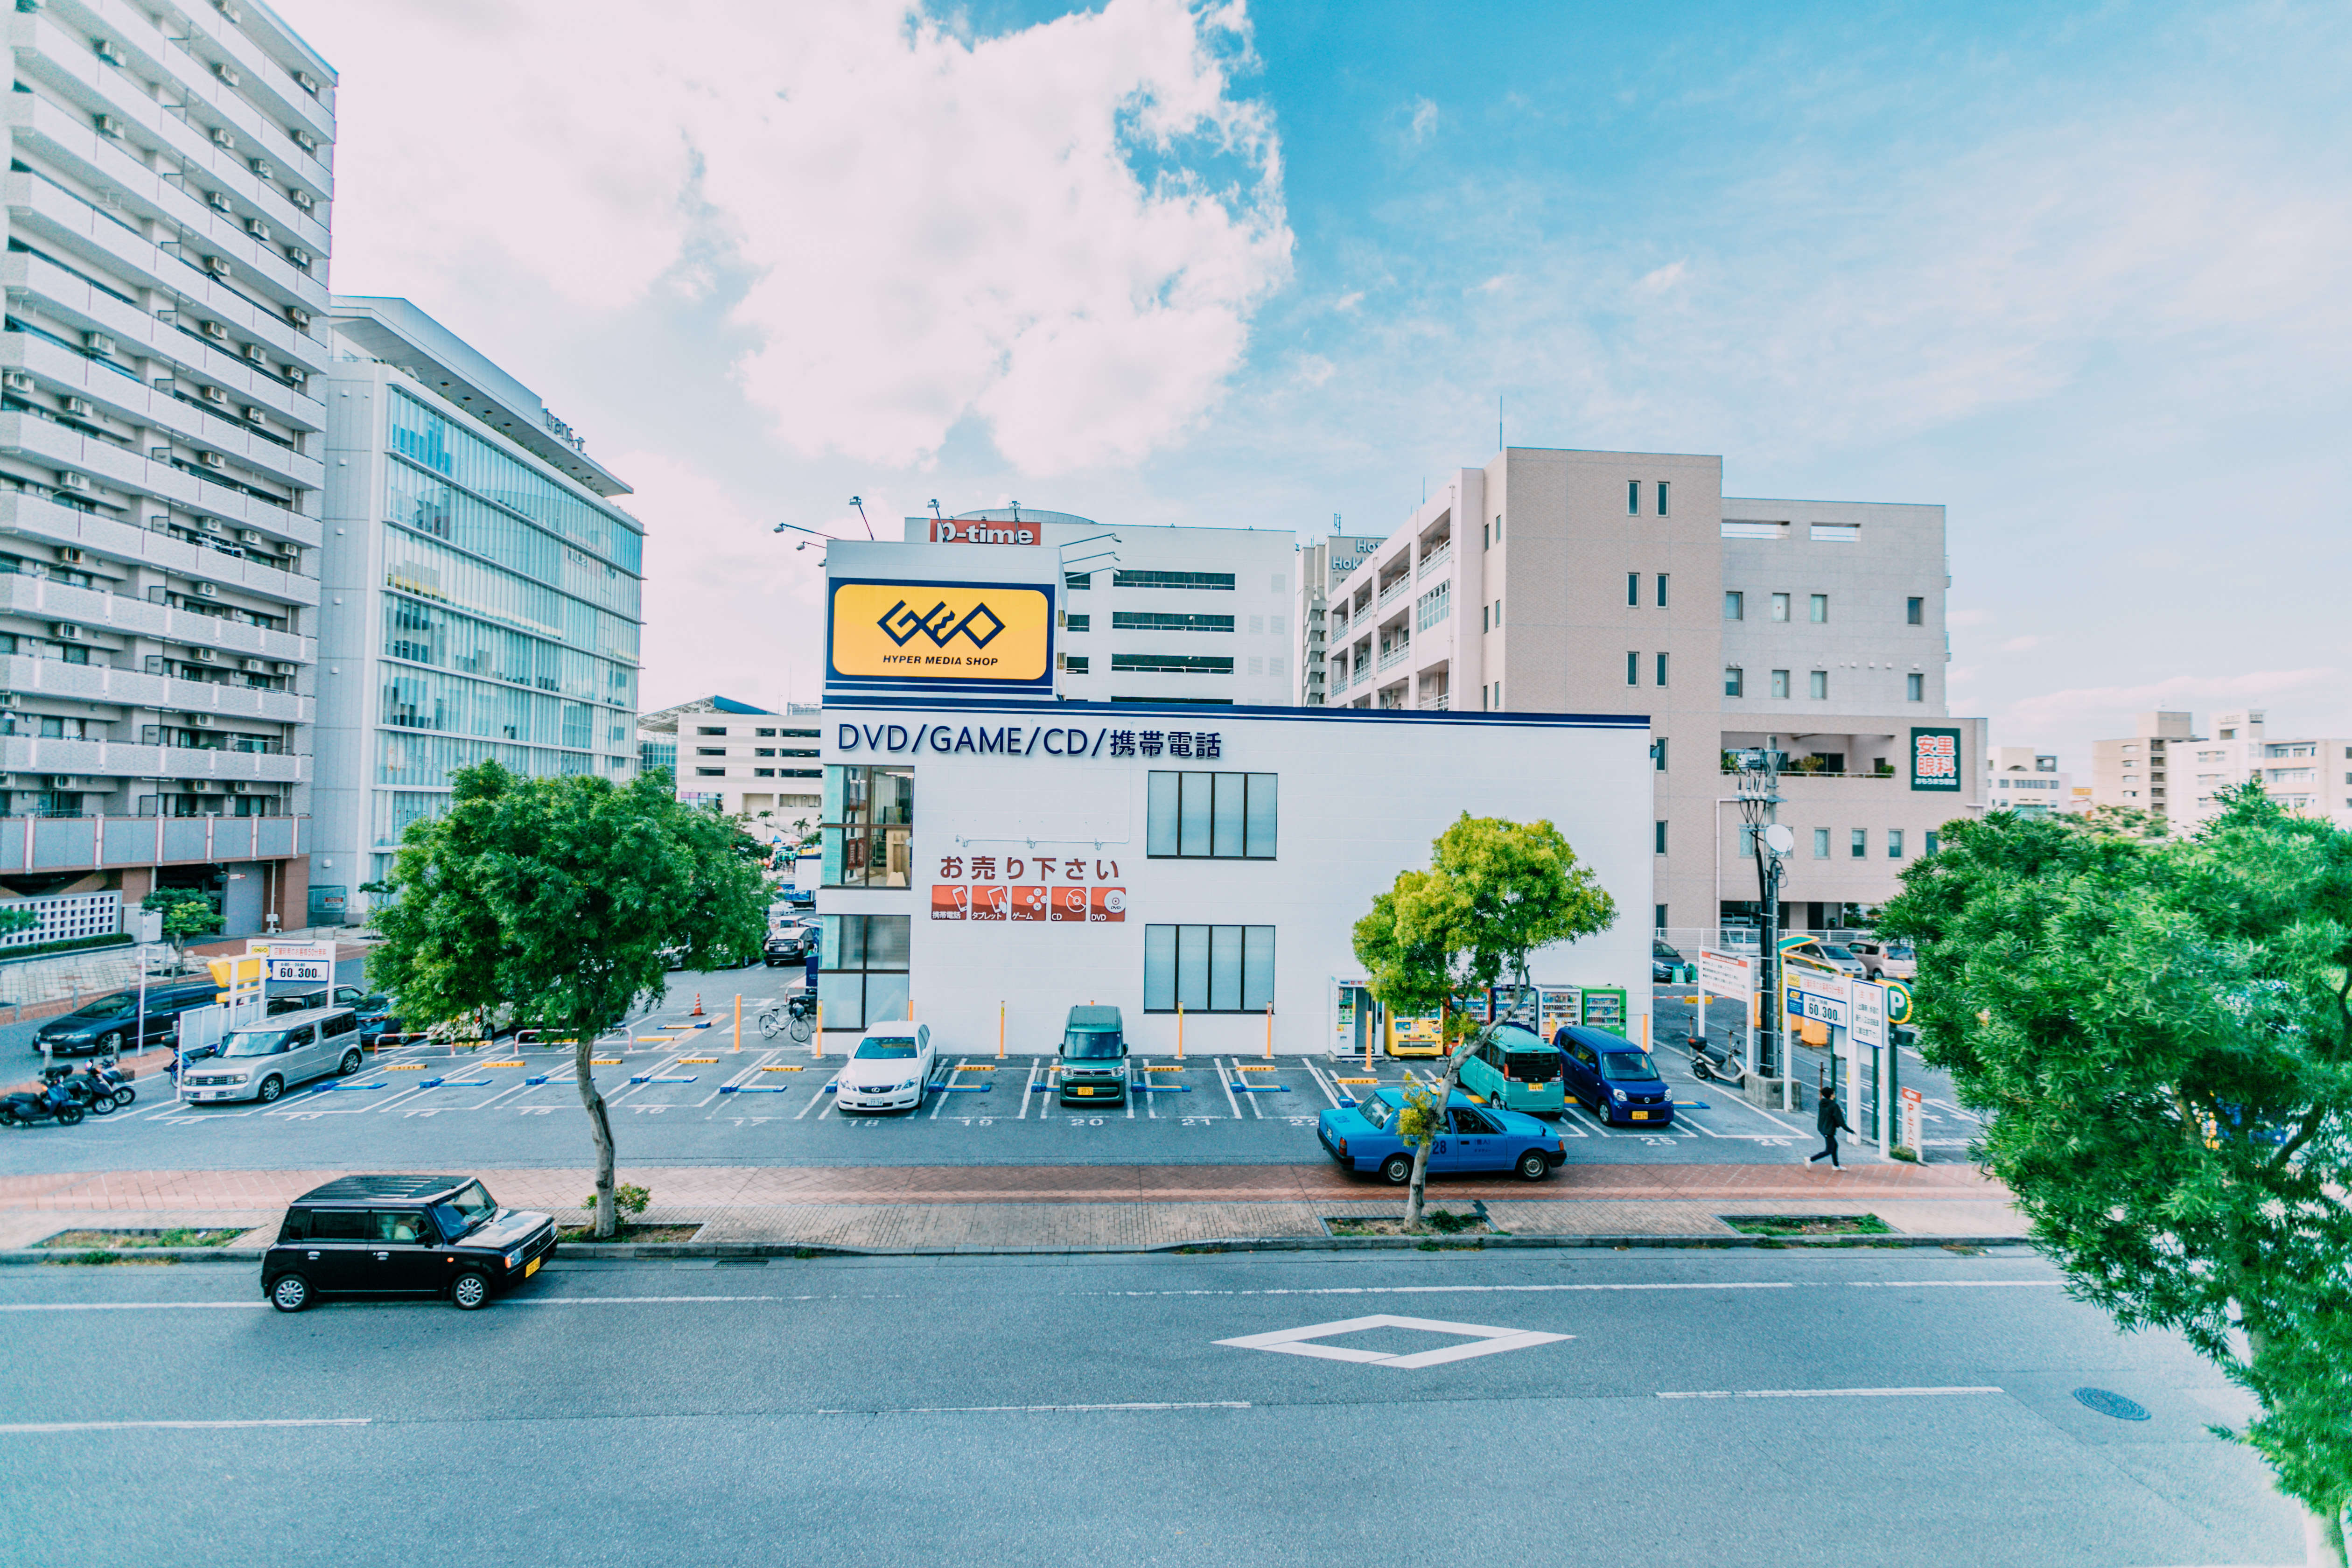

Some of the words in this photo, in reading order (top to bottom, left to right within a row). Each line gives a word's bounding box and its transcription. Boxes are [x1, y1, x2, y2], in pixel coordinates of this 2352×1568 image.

[877, 599, 1006, 649] GEO
[883, 655, 921, 664] HYPER
[925, 656, 961, 665] MEDIA
[966, 657, 998, 666] SHOP
[1916, 735, 1956, 756] 安里
[1916, 756, 1956, 777] 眼科
[940, 856, 1119, 881] お売り下さい
[932, 911, 961, 920] 携帯電話
[1890, 990, 1905, 1016] P
